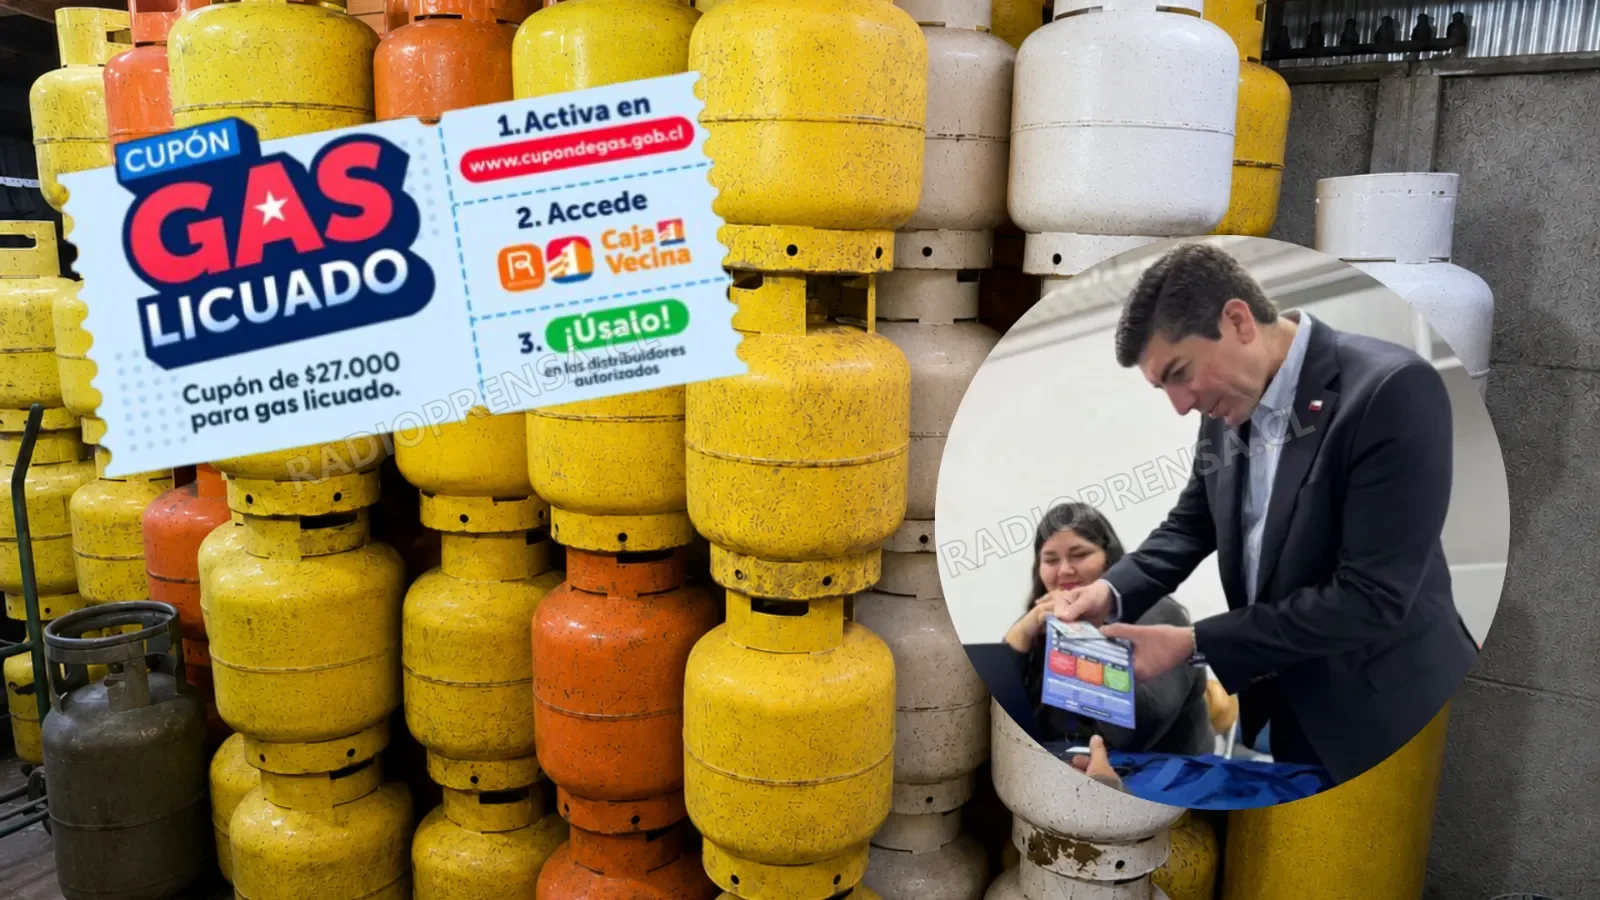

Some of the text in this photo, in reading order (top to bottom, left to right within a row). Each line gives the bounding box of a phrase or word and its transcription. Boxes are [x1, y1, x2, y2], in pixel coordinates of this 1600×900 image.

[617, 97, 651, 117] en
[124, 127, 230, 173] CUPÓN
[469, 125, 684, 174] www.cupondegas.gob.cl
[130, 141, 394, 284] GAS
[516, 191, 648, 229] 2. Accede
[601, 225, 655, 252] Caja
[605, 246, 692, 275] Vecina
[144, 248, 409, 348] LICUADO
[518, 304, 671, 354] 3. ¡Úsalo!
[182, 351, 400, 405] Cupón de $27.000
[545, 345, 687, 377] en los distribuidores
[574, 363, 660, 387] autorizados
[191, 379, 401, 434] para gas licuado.
